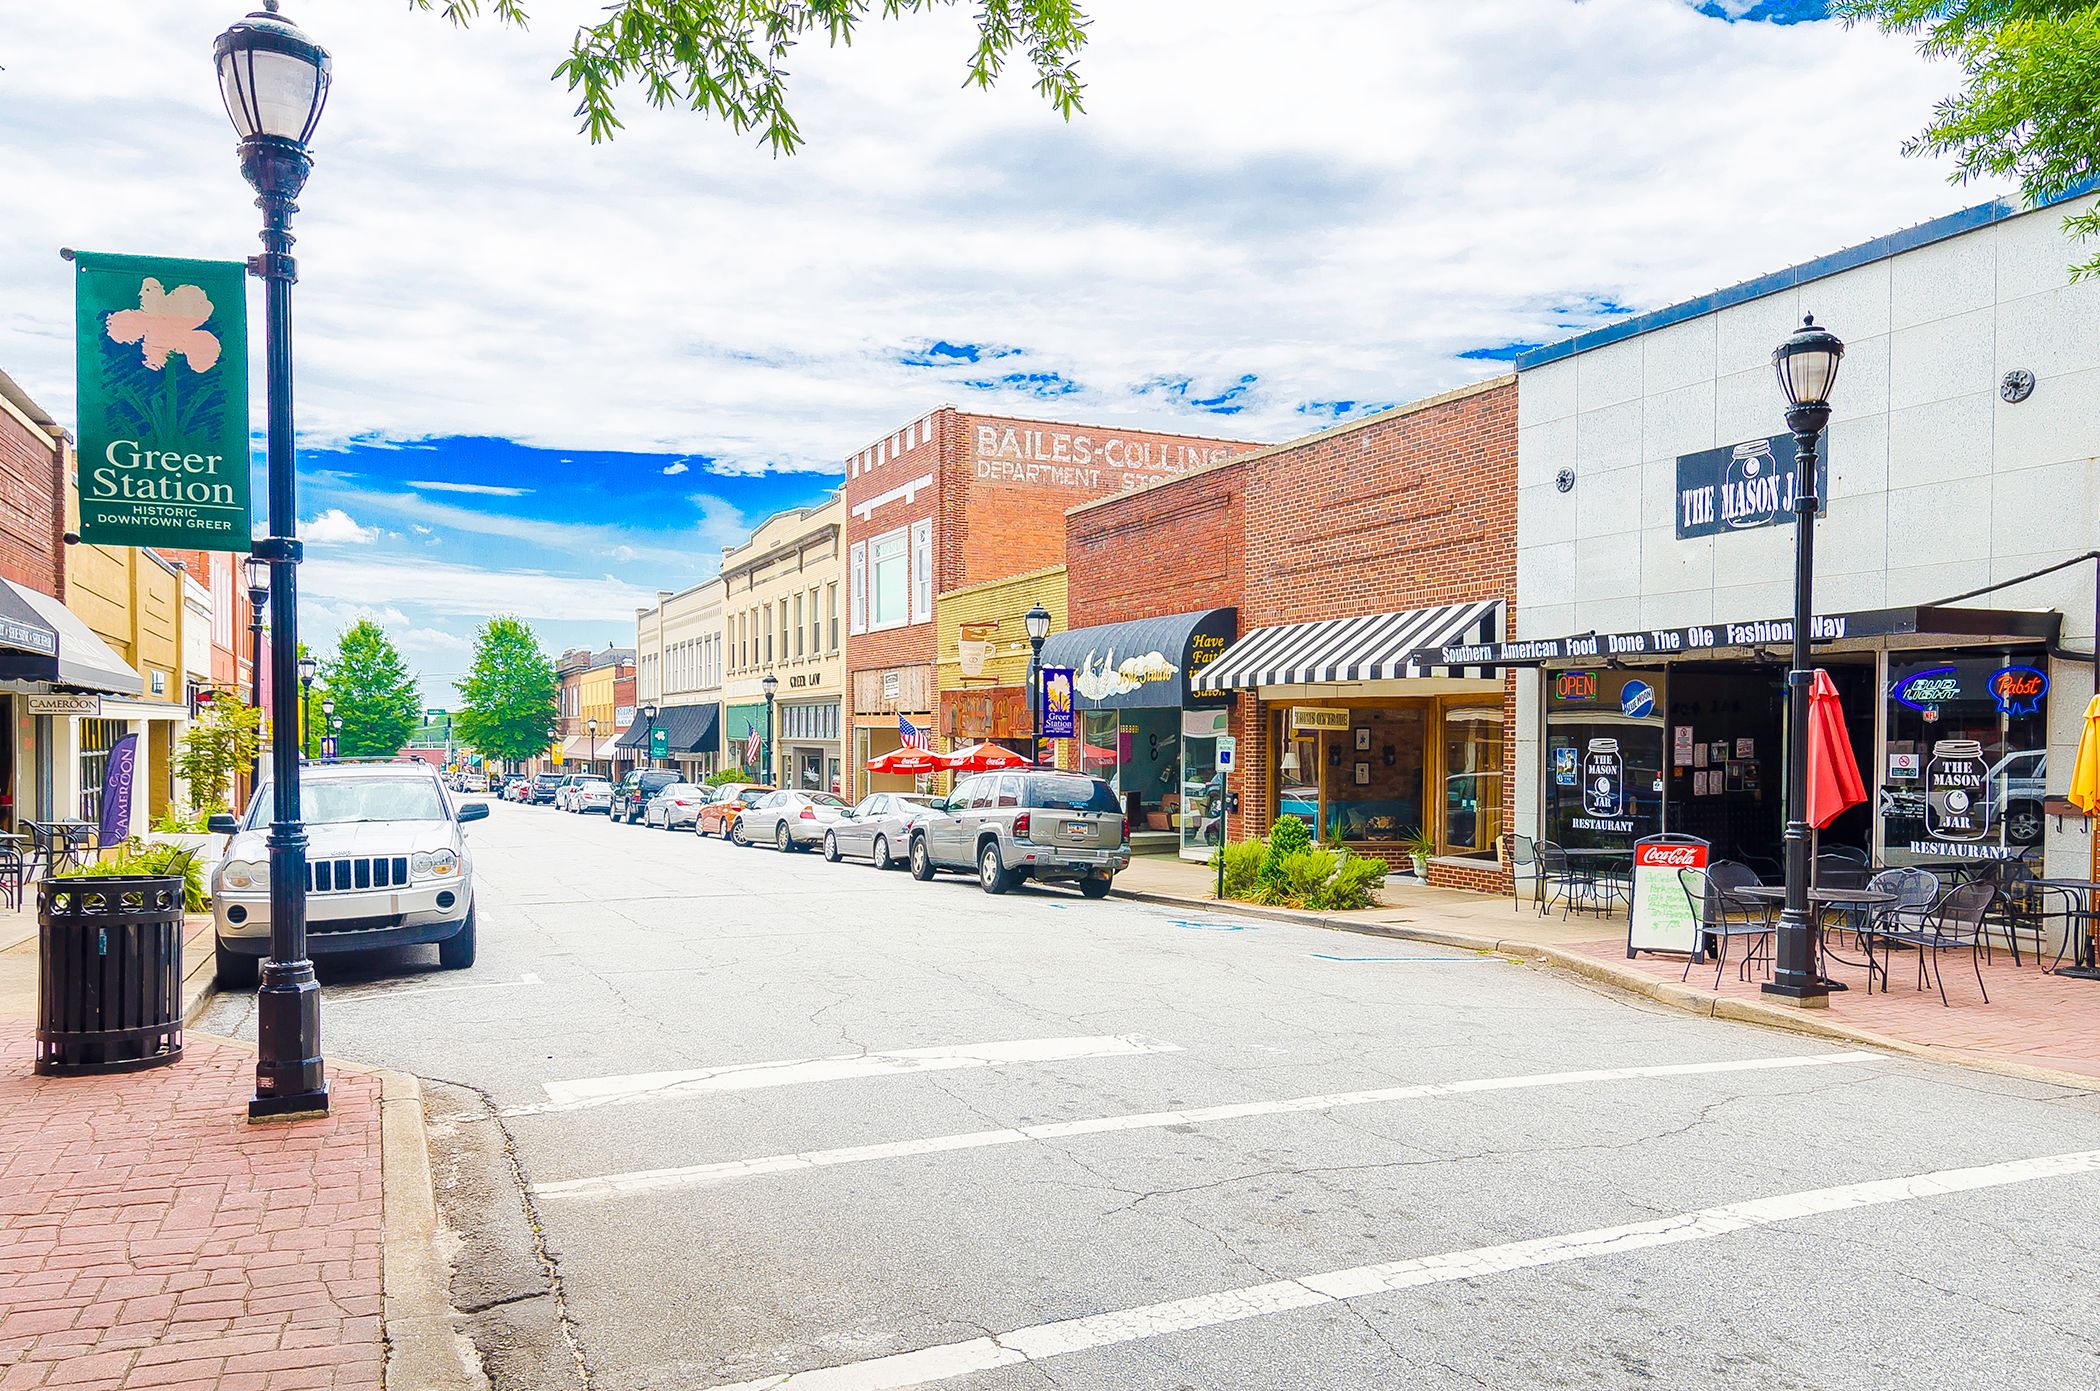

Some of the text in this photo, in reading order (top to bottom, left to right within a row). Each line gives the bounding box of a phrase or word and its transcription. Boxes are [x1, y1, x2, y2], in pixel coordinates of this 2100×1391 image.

[106, 440, 222, 474] Greer
[977, 460, 1101, 488] DEPARTMENT
[93, 468, 235, 504] Station
[1682, 485, 1715, 527] THE
[1721, 475, 1780, 519] MASON
[133, 505, 198, 518] HISTORIC
[97, 514, 232, 530] DOWNTOWN GREER
[1192, 634, 1224, 648] Have
[1442, 645, 1492, 664] Southern
[1501, 640, 1558, 660] American
[1565, 635, 1598, 656] Food
[1608, 634, 1645, 653] Done
[1651, 630, 1680, 649] The
[1688, 627, 1714, 647] Ole
[1726, 621, 1793, 644] Fashion
[1559, 676, 1594, 696] OPEN
[1911, 679, 1956, 690] BUD
[1997, 675, 2041, 695] Pabst
[1903, 689, 1960, 700] LIGHT
[29, 699, 97, 709] CAMEROON
[1048, 712, 1070, 721] Greer
[1925, 710, 1937, 720] NFL
[1045, 719, 1072, 728] Station
[1593, 755, 1613, 765] THE
[1588, 764, 1617, 775] MASON
[1942, 761, 1973, 773] THE
[1933, 774, 1981, 787] MASON
[115, 749, 133, 840] CAMEROON
[1593, 797, 1612, 808] JAR
[1572, 818, 1634, 832] RESTAURANT
[1942, 816, 1971, 829] JAR
[1643, 847, 1698, 865] Coca-Cola
[1910, 840, 2012, 860] RESTAURANT
